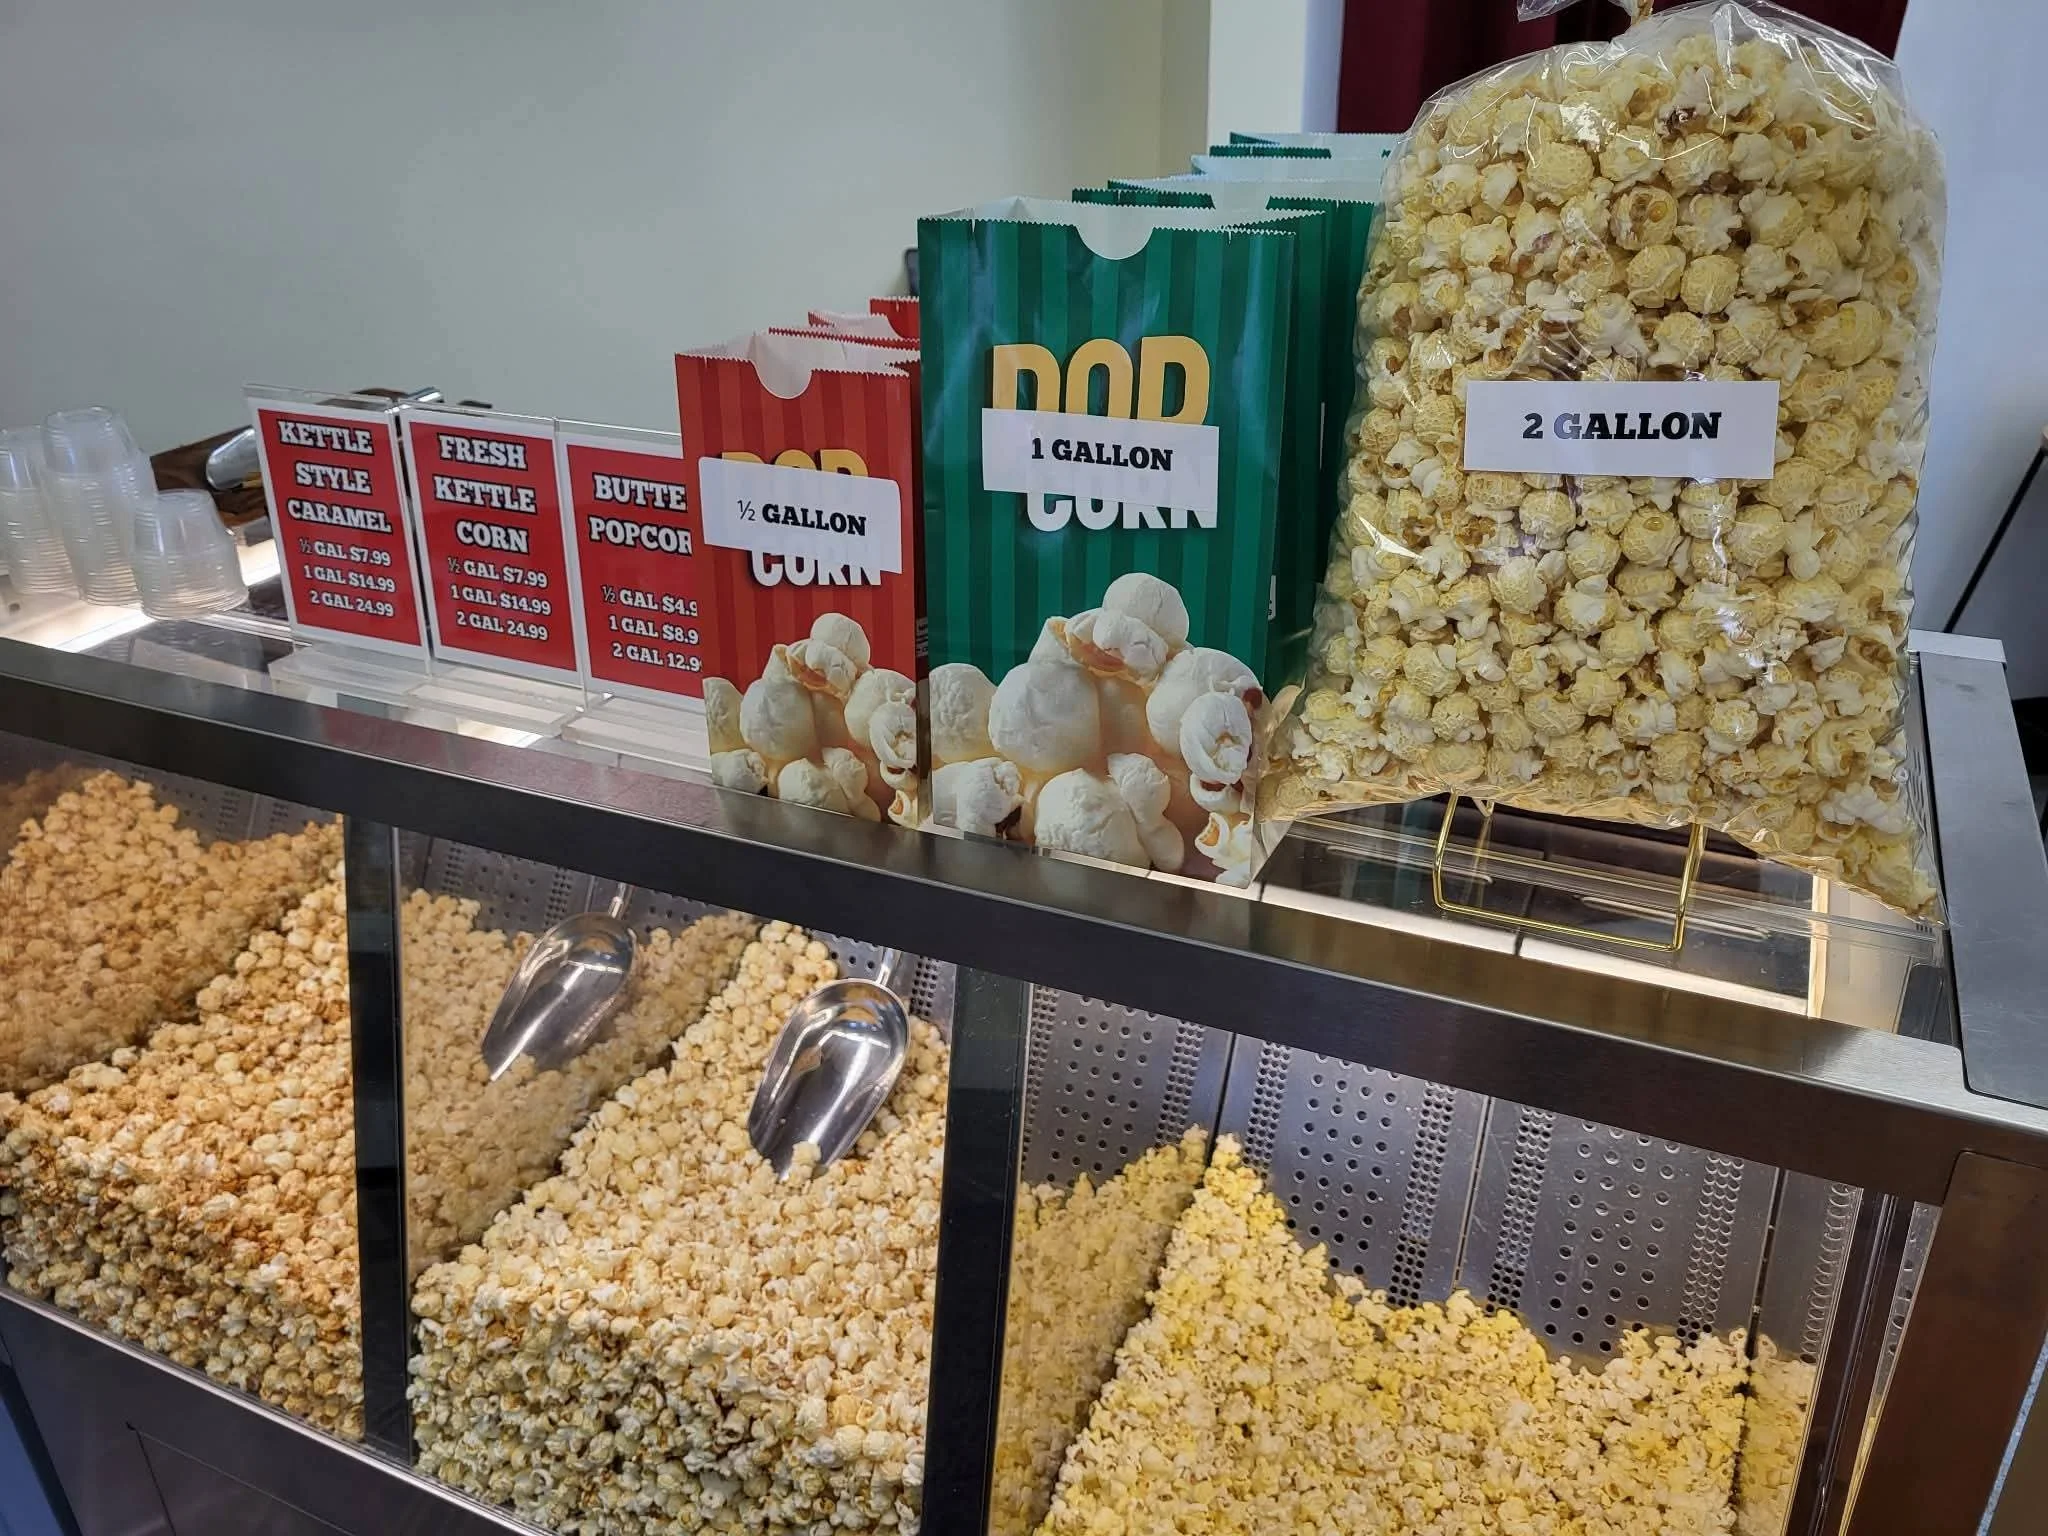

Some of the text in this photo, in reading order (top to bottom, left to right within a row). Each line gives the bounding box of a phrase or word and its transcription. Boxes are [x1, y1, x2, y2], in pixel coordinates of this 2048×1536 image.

[278, 420, 373, 454] KETTLE
[1522, 411, 1722, 440] 2 GALLON
[438, 433, 527, 470] FRESH
[1031, 437, 1173, 471] 1 GALLON
[296, 460, 371, 494] STYLE
[592, 472, 688, 512] BUTTE
[433, 474, 537, 515] KETTLE
[288, 499, 392, 533] CARAMEL
[762, 503, 866, 536] GALLON
[456, 520, 529, 554] CORN
[588, 515, 692, 556] POPCOR
[314, 541, 347, 560] GAL
[350, 548, 391, 567] $7.99
[304, 564, 395, 593] 1 GAL $14.99
[463, 561, 500, 580] GAL
[502, 566, 548, 589] $7.99
[311, 590, 394, 617] 2 GAL 24.99
[451, 585, 551, 616] 1 GAL $14.99
[619, 589, 658, 610] GAL
[662, 594, 698, 617] $4.9
[456, 611, 548, 641] 2 GAL 24.99
[609, 615, 699, 645] 1 GAL $8.9
[613, 643, 702, 672] 2 GAL 12.9
